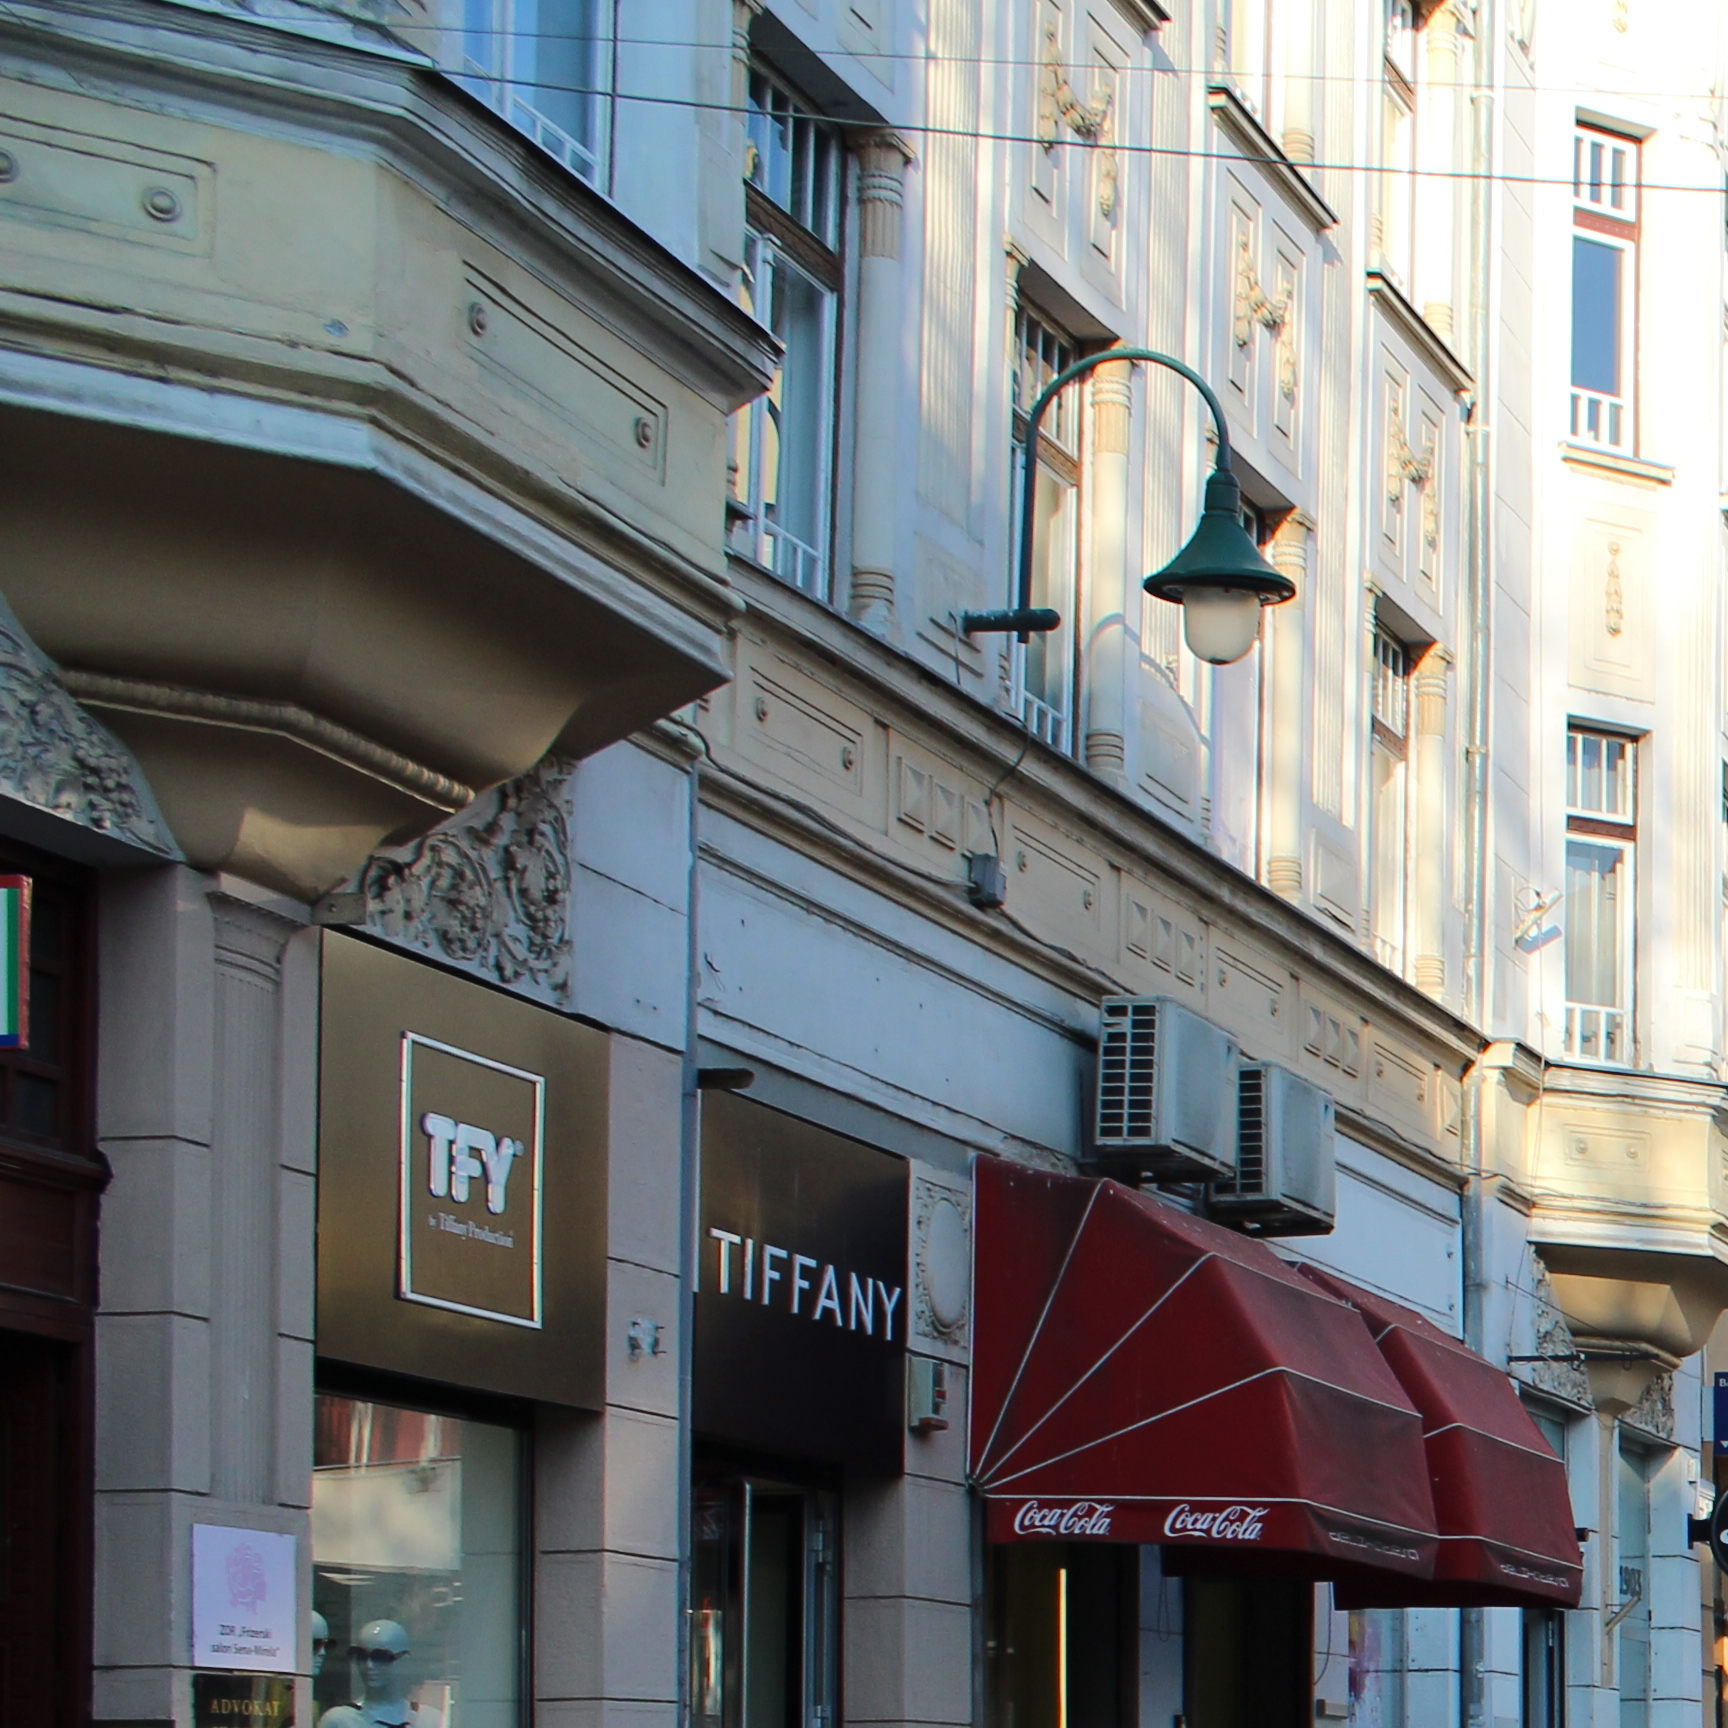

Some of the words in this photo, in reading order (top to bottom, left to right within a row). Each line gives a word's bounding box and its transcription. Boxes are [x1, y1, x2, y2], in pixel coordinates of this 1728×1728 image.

[421, 1112, 514, 1215] TFY
[708, 1227, 901, 1341] TIFFANY
[210, 1698, 280, 1717] ADVOKAT
